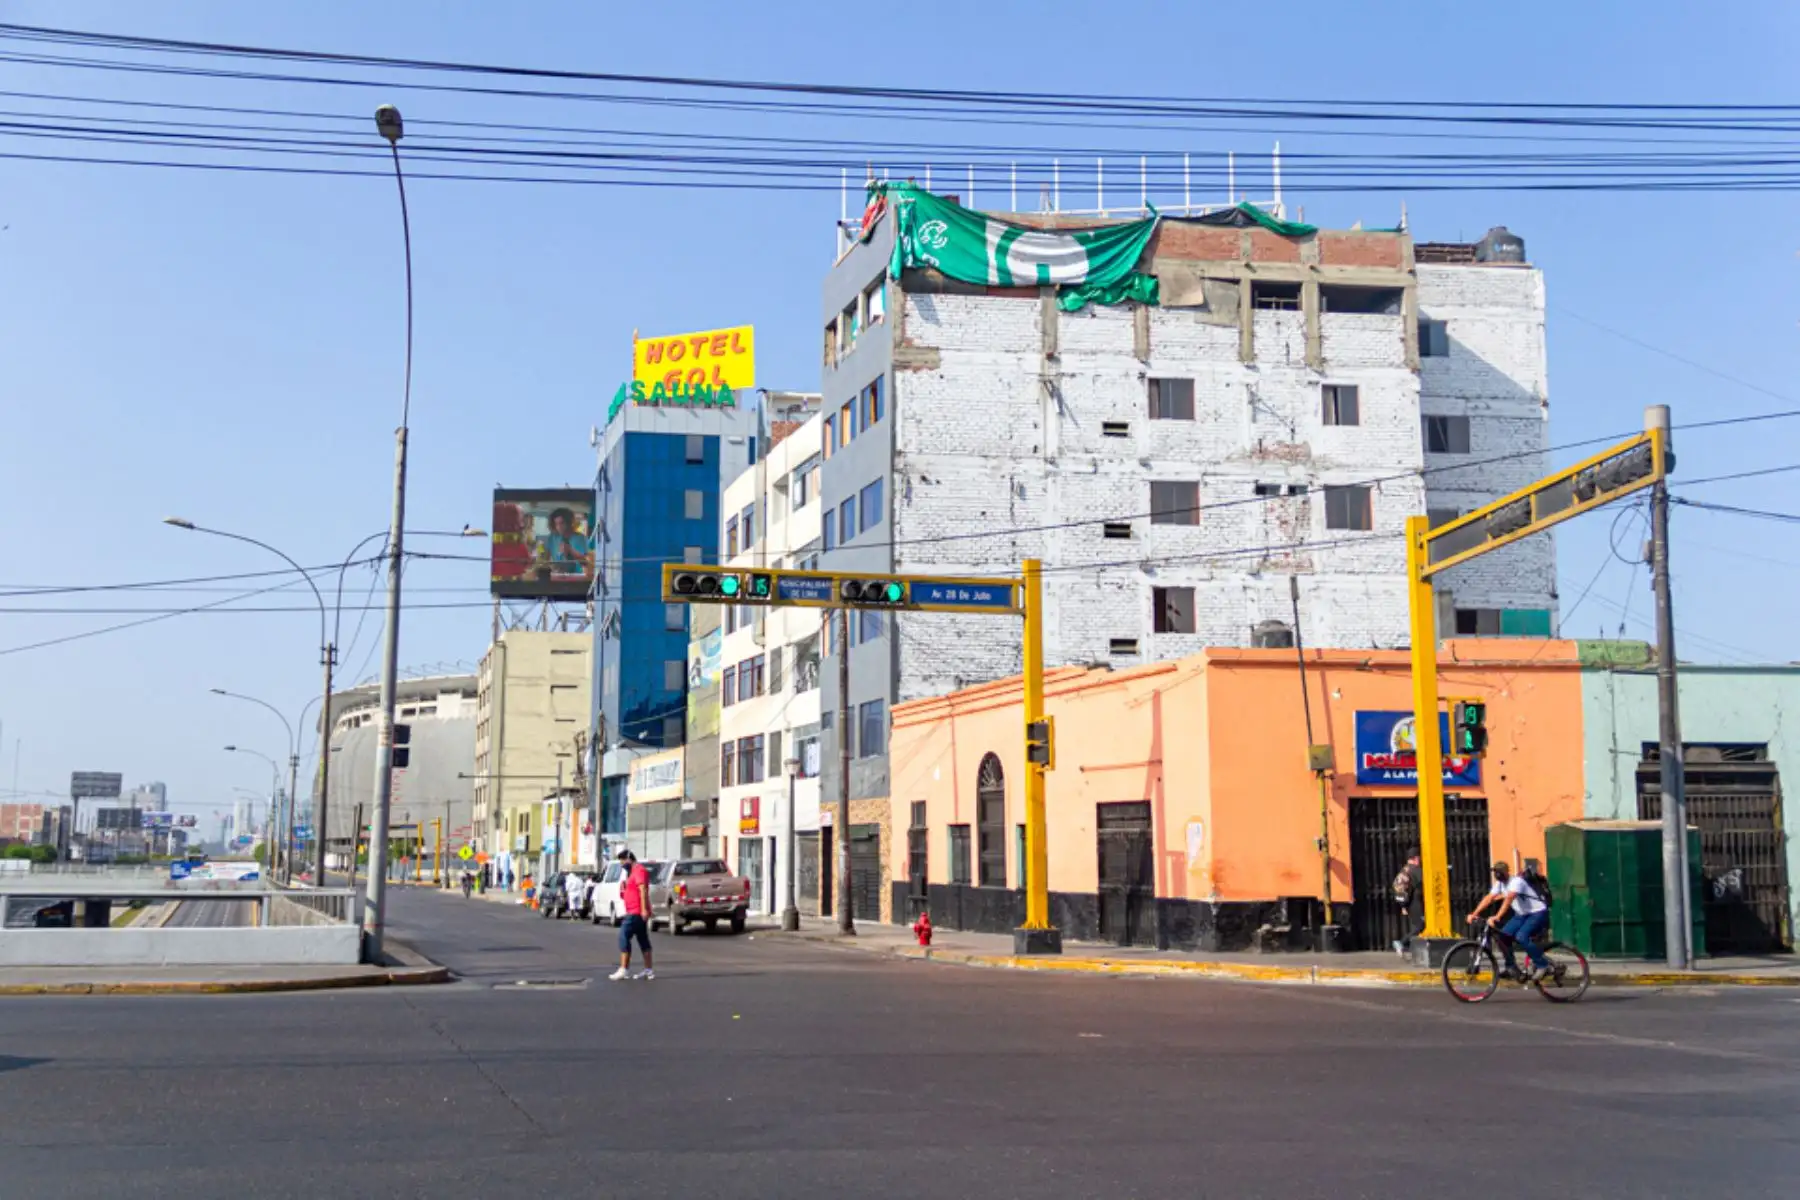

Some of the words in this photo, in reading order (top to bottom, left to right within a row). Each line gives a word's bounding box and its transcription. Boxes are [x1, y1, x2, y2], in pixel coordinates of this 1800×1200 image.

[646, 332, 746, 364] HOTEL
[663, 364, 727, 391] GOL
[630, 380, 735, 408] SAUNA
[946, 589, 957, 600] 28
[1393, 771, 1406, 779] LA
